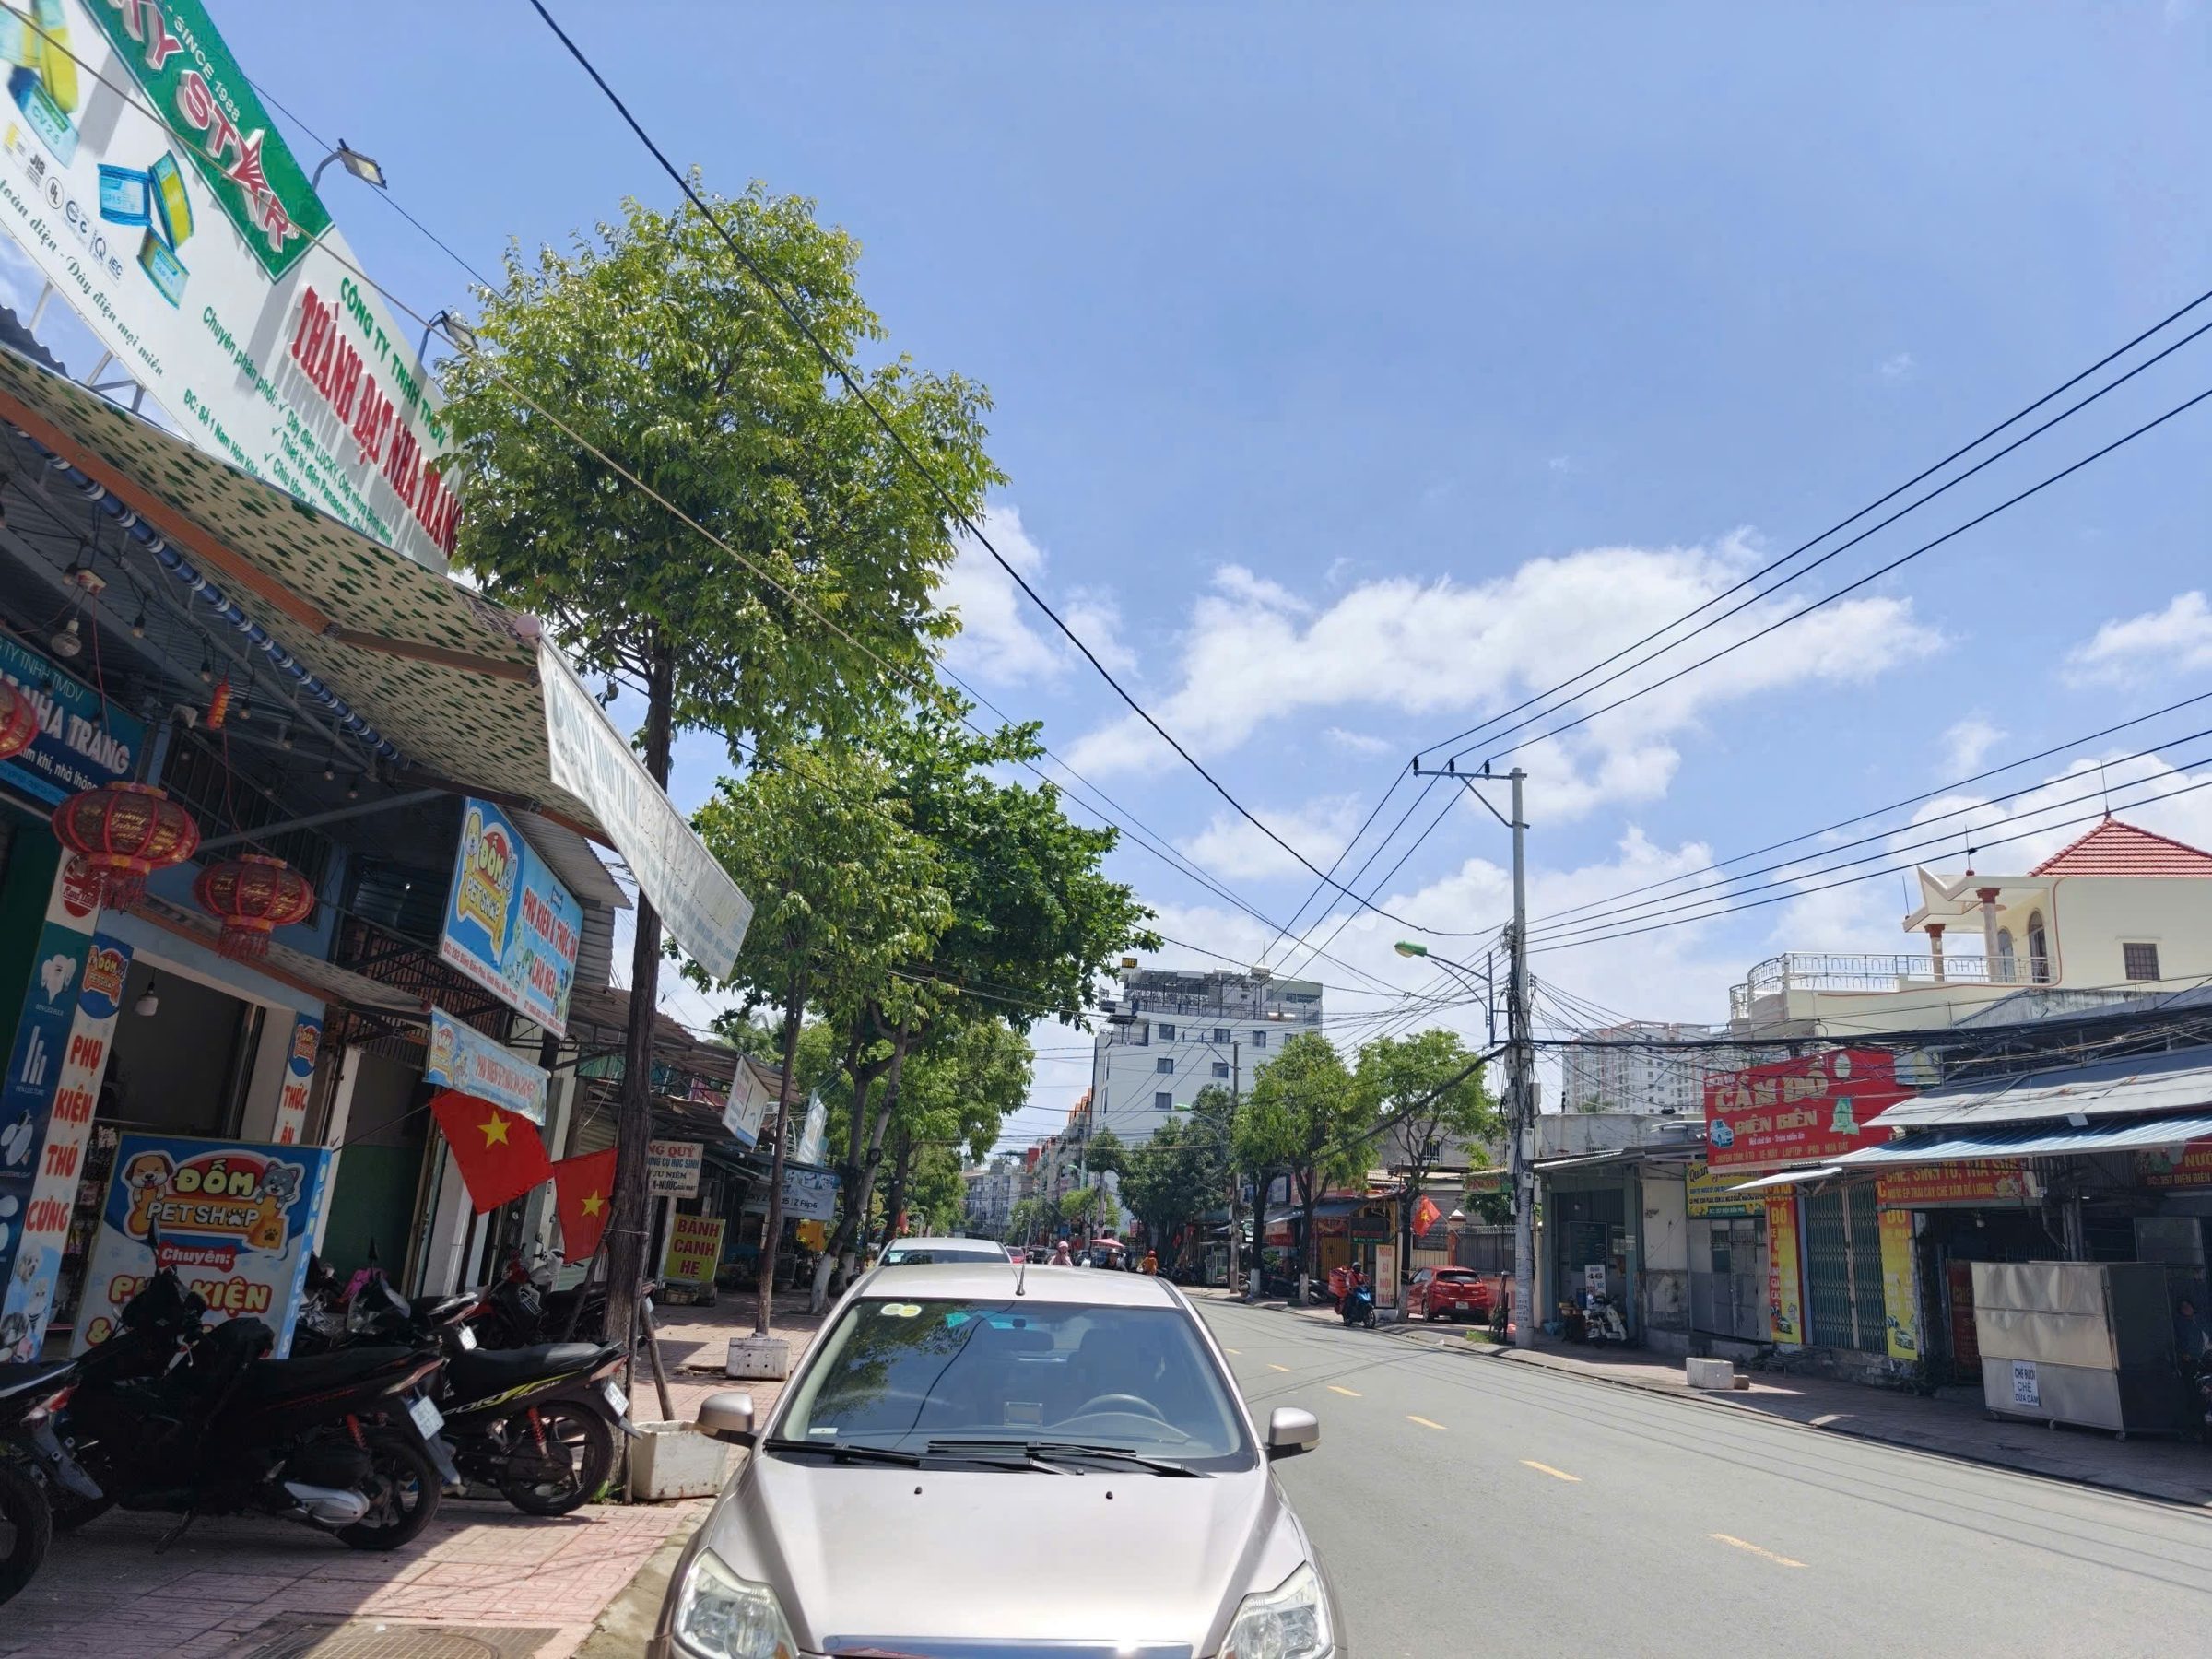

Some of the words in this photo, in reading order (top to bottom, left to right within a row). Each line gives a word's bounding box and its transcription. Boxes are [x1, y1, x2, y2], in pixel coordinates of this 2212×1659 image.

[174, 16, 214, 80] SINCE
[213, 80, 241, 121] 1988
[29, 154, 46, 176] JIS
[108, 255, 124, 276] IEC
[202, 305, 234, 359] Chuyên
[232, 349, 257, 383] phân
[340, 276, 374, 338] CÔNG
[374, 326, 391, 362] TY
[390, 352, 420, 407] TNHH
[214, 423, 230, 450] Nam
[382, 416, 422, 509] NHA
[4, 641, 19, 662] TY
[19, 653, 50, 680] TNHH
[52, 671, 84, 703] TMDV
[65, 712, 131, 774] TRANG
[521, 884, 537, 930] PHỤ
[69, 1033, 103, 1072] PHỤ
[53, 1085, 94, 1132] KIỆN
[283, 1082, 307, 1111] THỨC
[47, 1143, 79, 1181] THÚ
[667, 1144, 696, 1159] QUÝ
[685, 1159, 700, 1170] SINH
[1783, 1147, 1803, 1158] LAPTOP
[174, 1159, 255, 1197] ĐỐM
[147, 1202, 194, 1222] PET
[800, 1198, 818, 1209] Flip5
[677, 1218, 721, 1237] BÁNH
[161, 1247, 229, 1265] Chuyên:
[674, 1239, 716, 1256] CANH
[679, 1259, 700, 1278] HẸ
[191, 1277, 270, 1314] KIỆN
